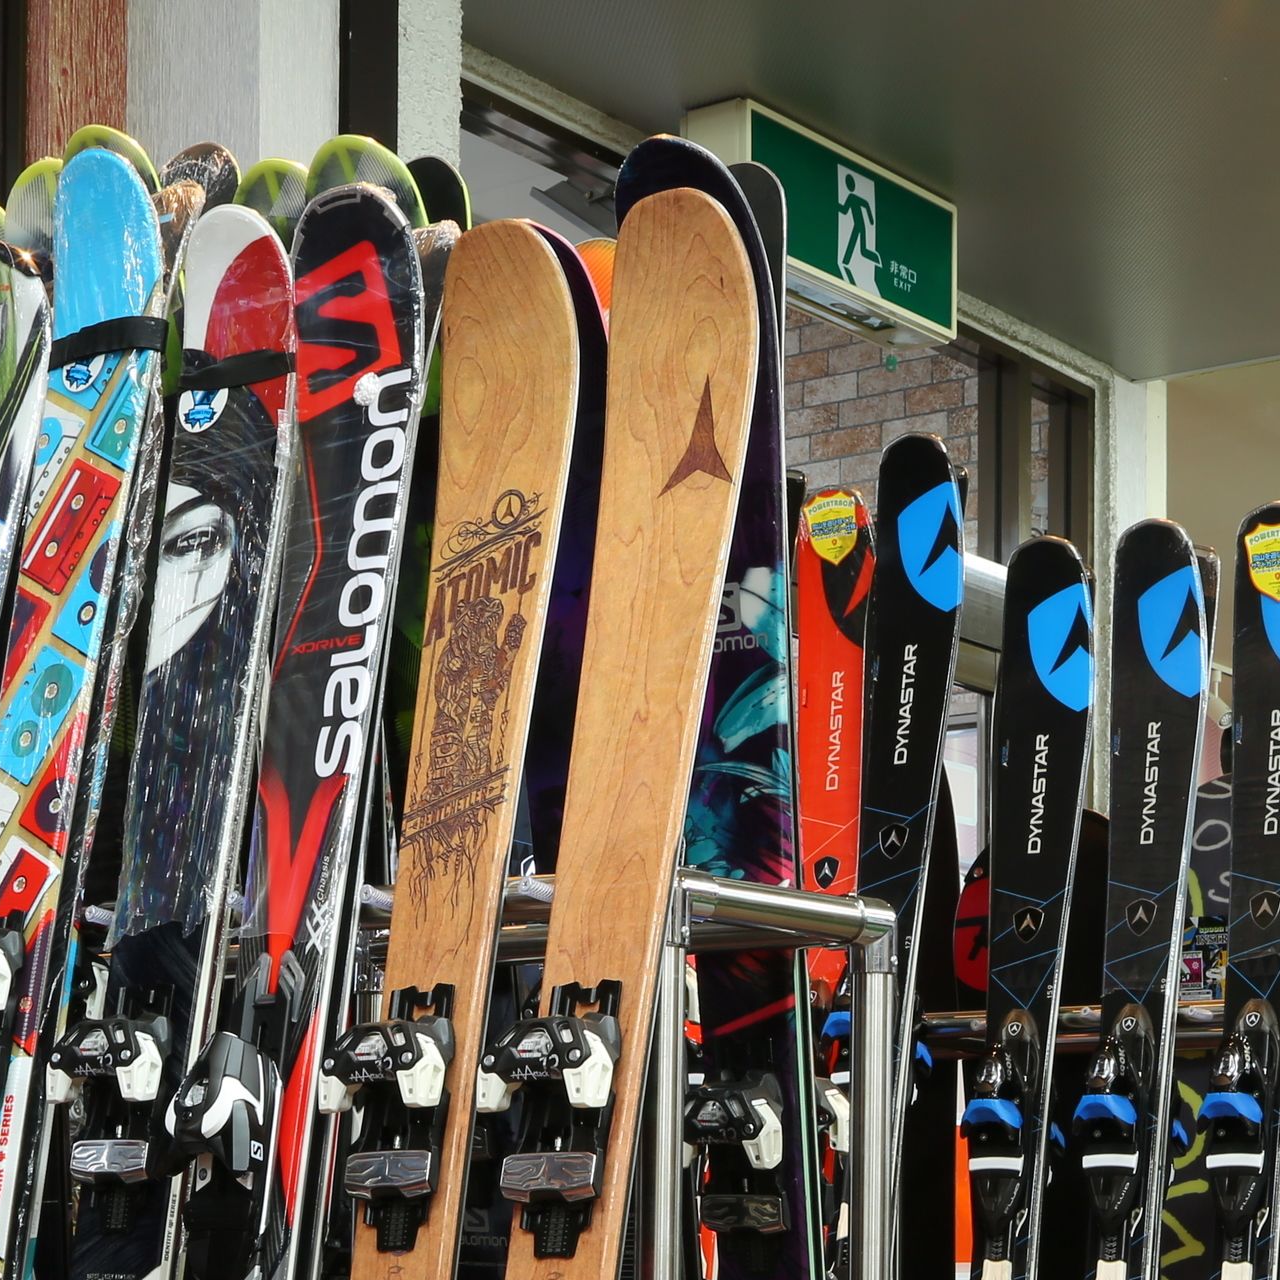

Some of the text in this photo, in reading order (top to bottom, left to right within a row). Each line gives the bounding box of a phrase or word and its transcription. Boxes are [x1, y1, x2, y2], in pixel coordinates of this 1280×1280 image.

[890, 260, 917, 284] 非常口
[894, 278, 912, 293] EXIT
[314, 368, 412, 778] salomon
[423, 531, 542, 649] ATOMIC
[713, 632, 769, 653] omon
[826, 671, 845, 791] DYNASTAR
[894, 644, 918, 765] DYNASTAR
[1027, 733, 1050, 854] DYNASTAR
[1140, 721, 1162, 845] DYNASTAR
[0, 1094, 15, 1146] SERIES
[463, 1236, 507, 1248] alomon
